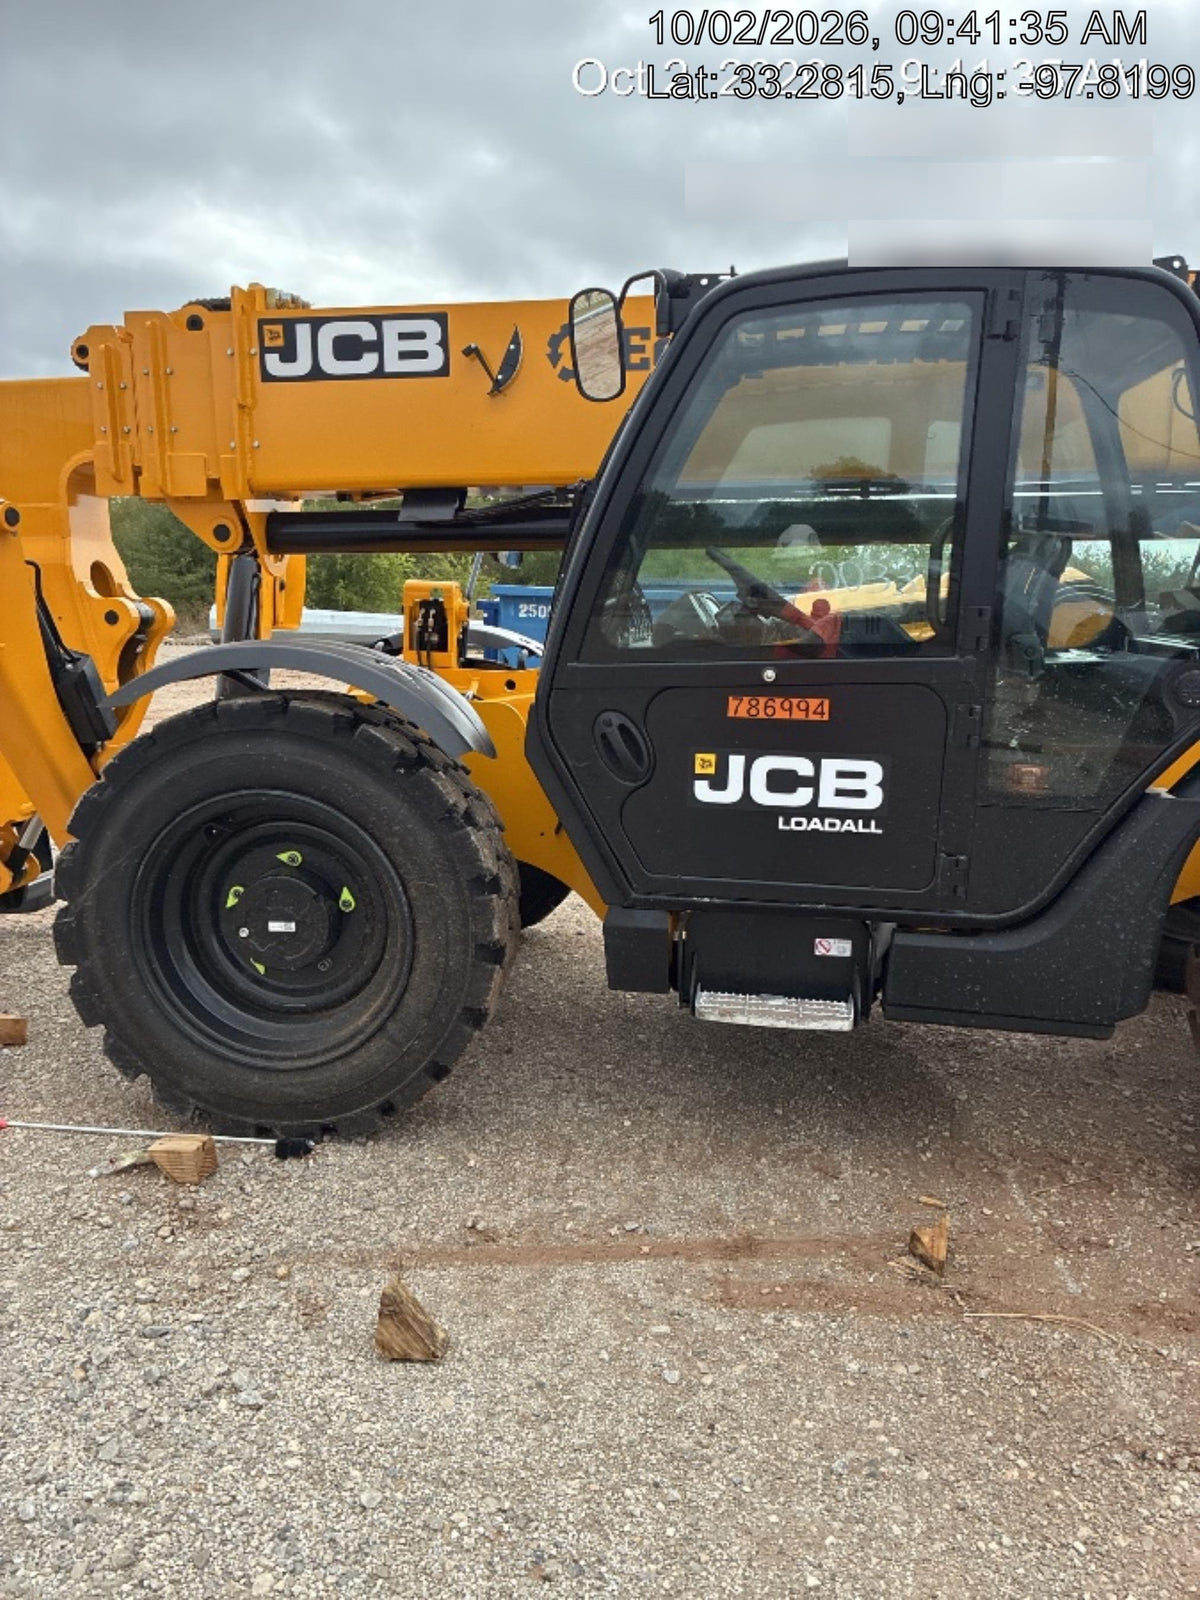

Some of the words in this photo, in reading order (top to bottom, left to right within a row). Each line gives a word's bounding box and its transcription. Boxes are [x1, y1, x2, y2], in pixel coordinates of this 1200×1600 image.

[264, 319, 445, 377] JCB
[731, 698, 827, 719] 786994
[694, 755, 884, 810] JCB
[778, 816, 882, 834] LOADALL
